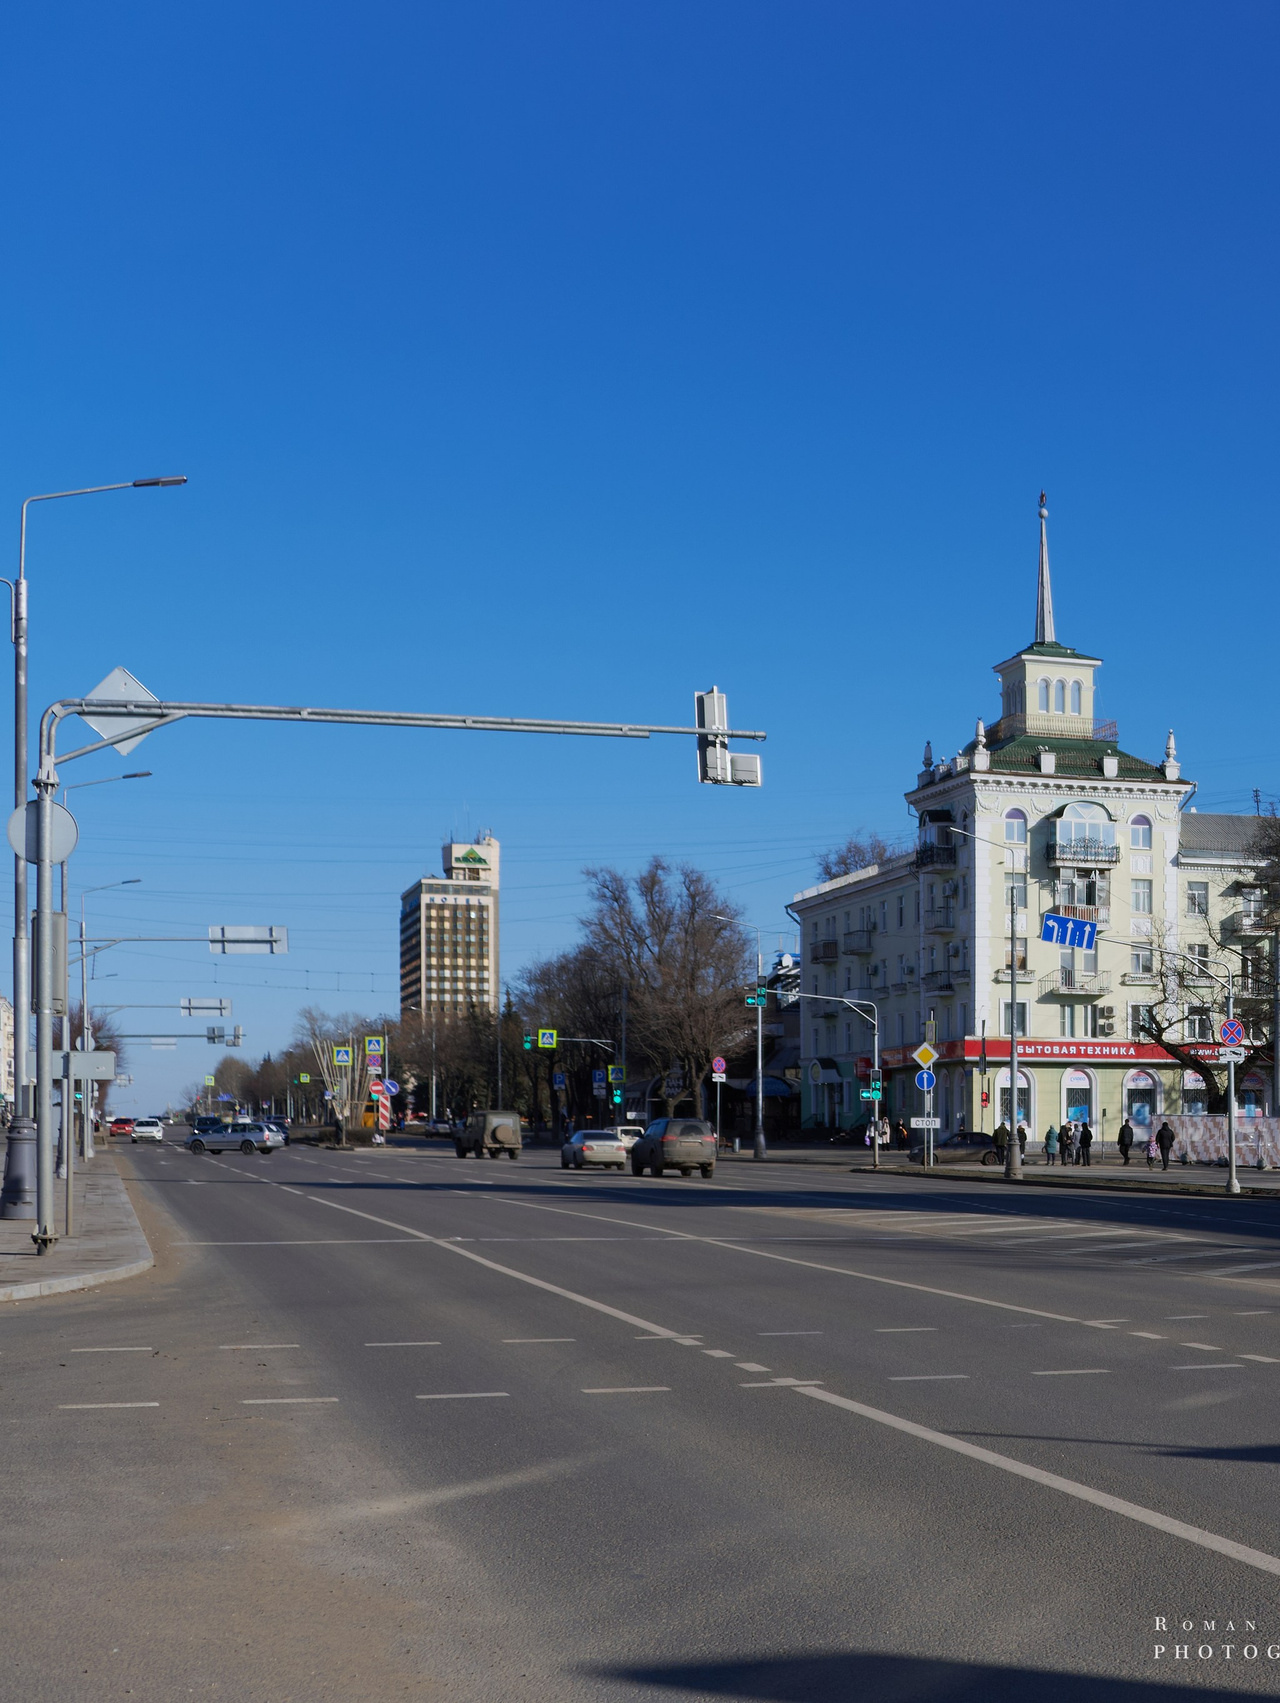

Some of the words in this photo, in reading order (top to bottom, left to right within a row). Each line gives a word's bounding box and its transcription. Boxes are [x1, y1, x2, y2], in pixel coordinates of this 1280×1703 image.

[1017, 1045, 1077, 1055] БЫТОВАЯ
[1080, 1046, 1136, 1055] ТЕХНИКА
[914, 1118, 937, 1127] СТОП
